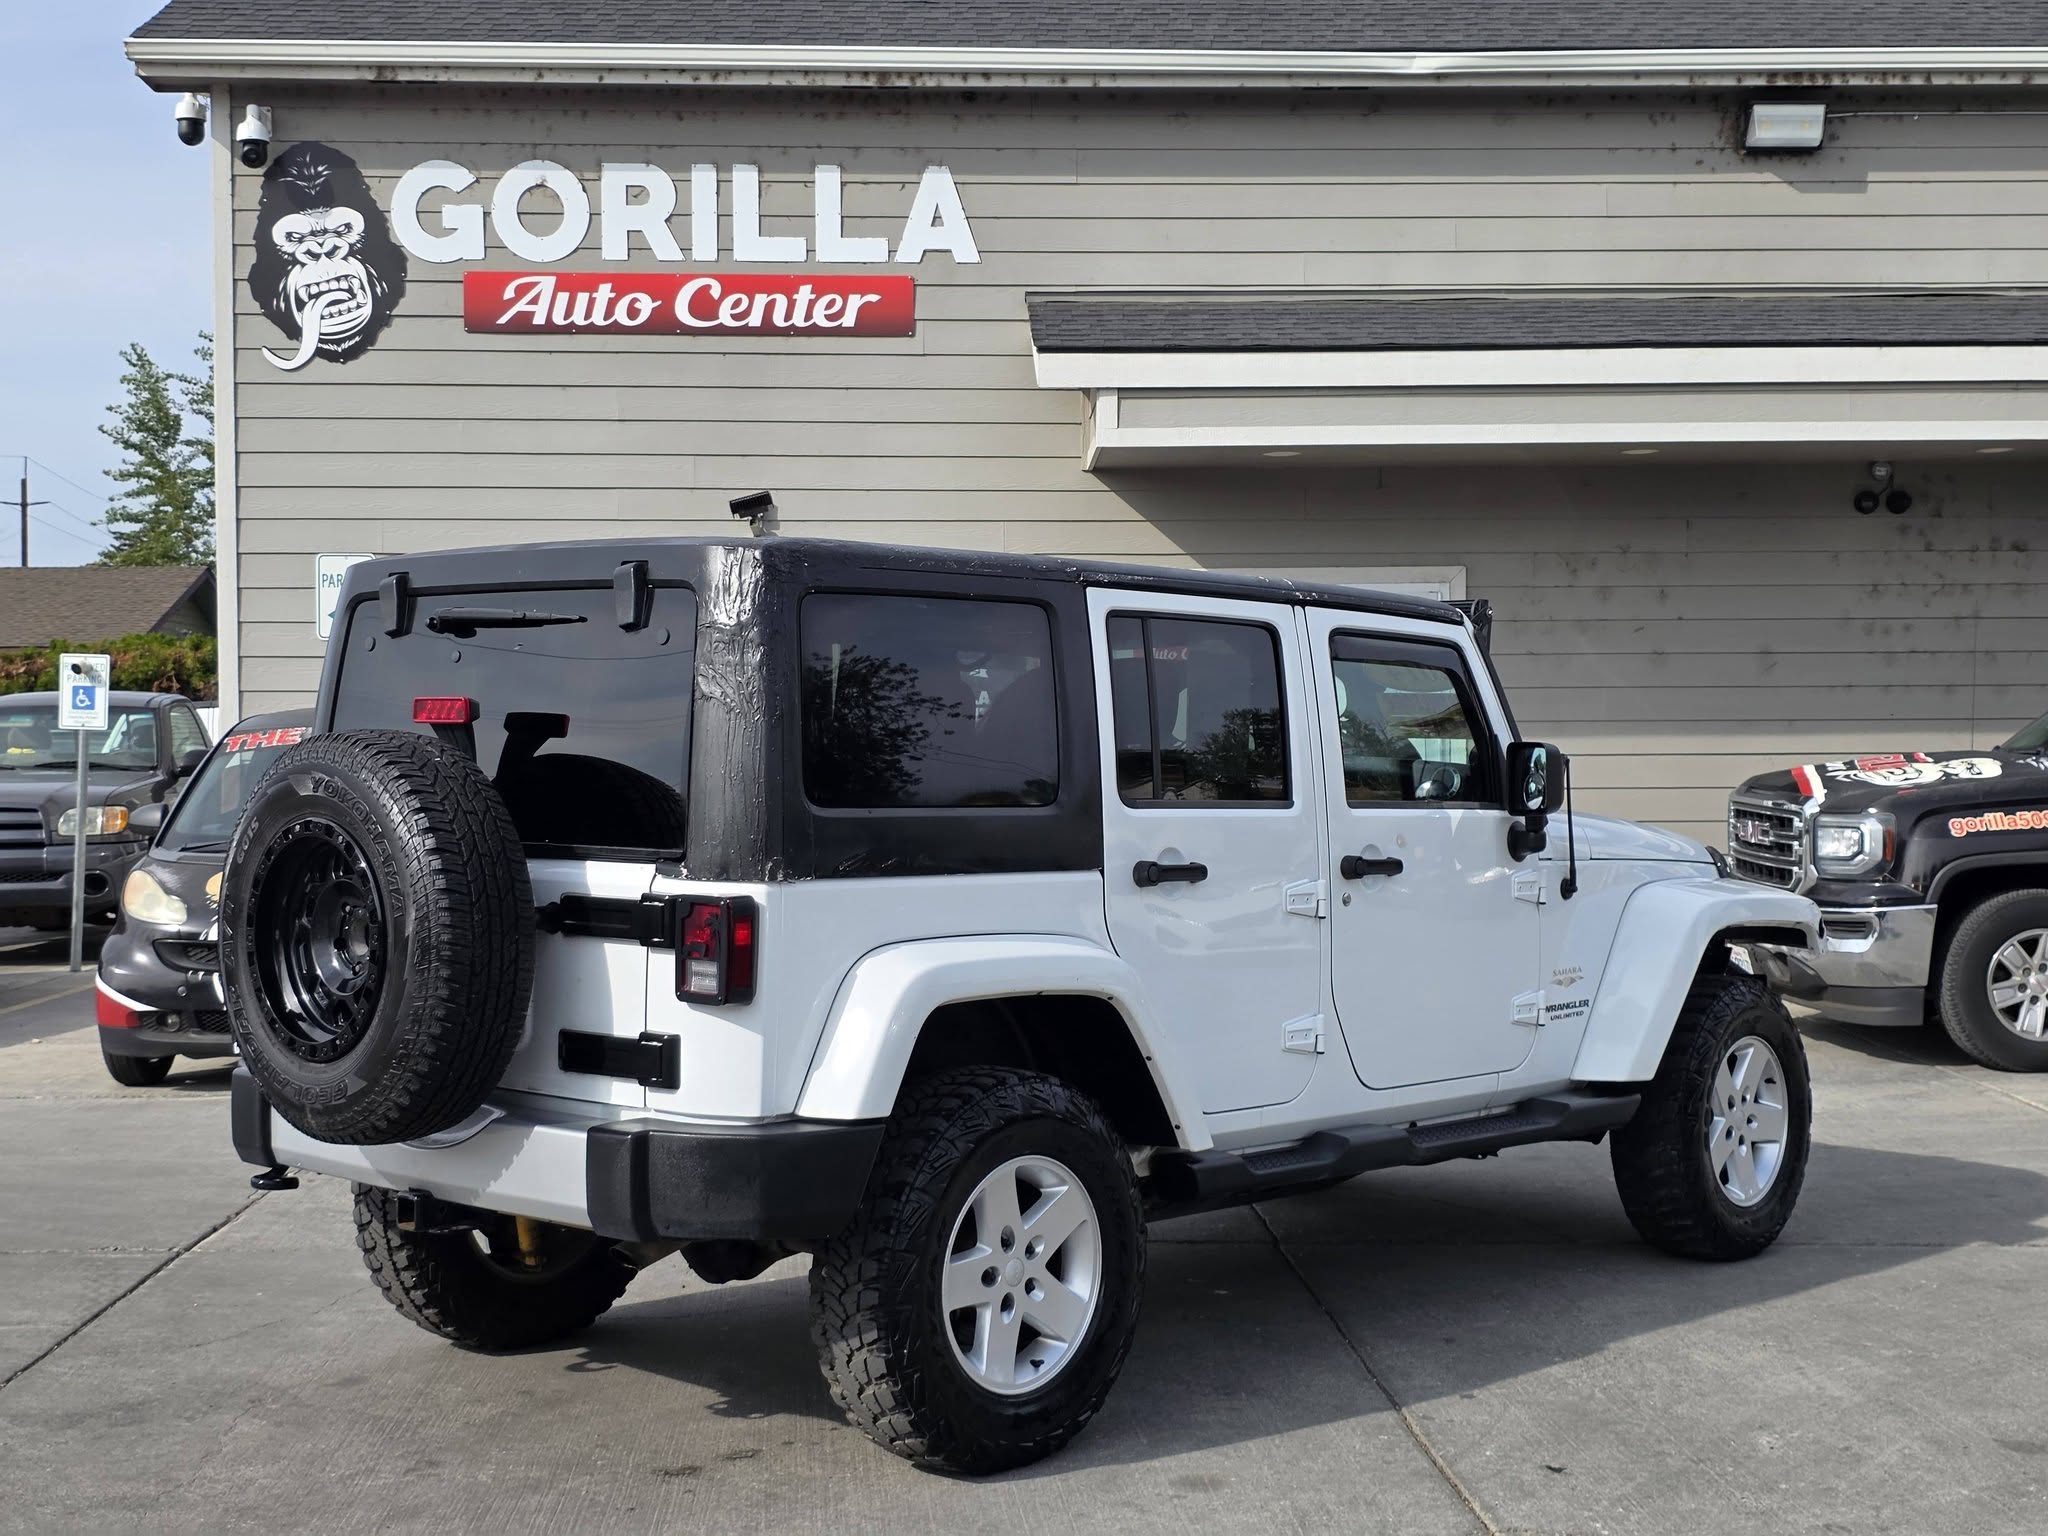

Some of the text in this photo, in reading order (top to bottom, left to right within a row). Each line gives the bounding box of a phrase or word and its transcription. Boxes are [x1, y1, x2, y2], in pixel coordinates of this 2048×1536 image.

[390, 159, 982, 264] GORILLA
[495, 275, 882, 329] Auto Center
[223, 727, 307, 753] THE
[311, 775, 405, 919] YOKOHAMA
[1552, 966, 1583, 977] SAHARA
[1550, 1010, 1585, 1021] UNLIMITED
